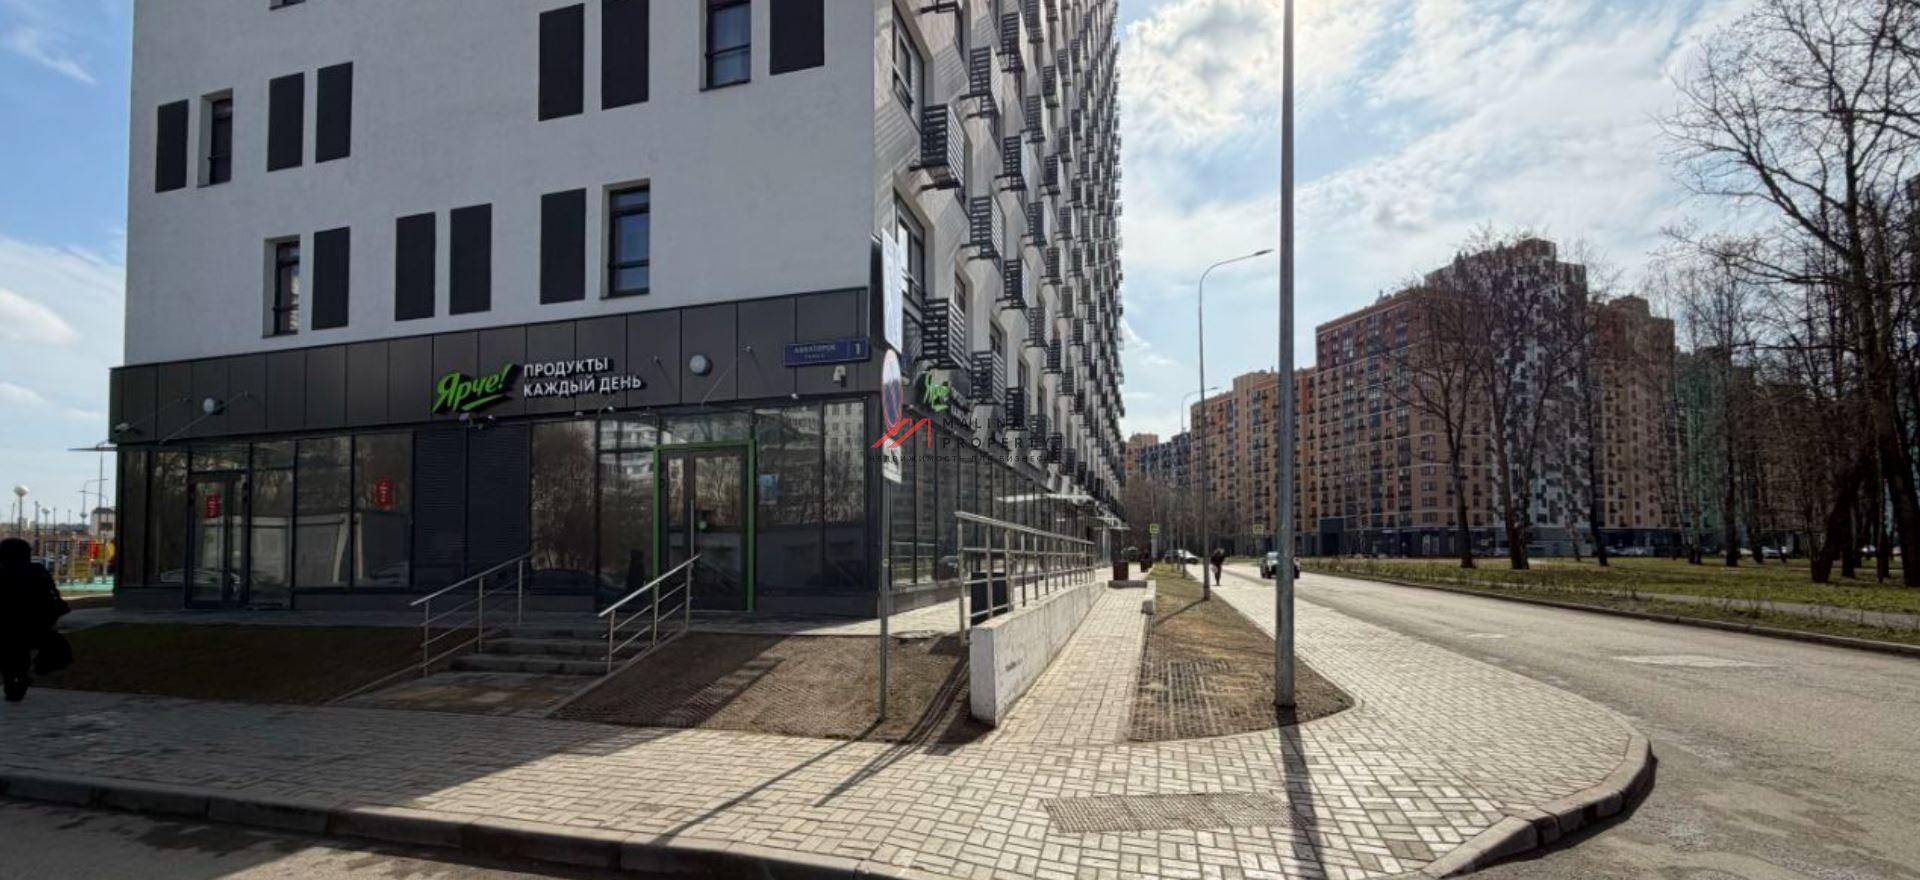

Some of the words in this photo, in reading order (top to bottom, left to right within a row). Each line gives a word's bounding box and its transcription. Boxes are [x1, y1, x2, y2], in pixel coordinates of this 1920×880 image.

[523, 357, 609, 378] ПРОДУКТЫ
[432, 363, 515, 412] Ярче!
[523, 377, 596, 397] КАЖДЫЙ
[600, 374, 642, 392] ДЕНЬ
